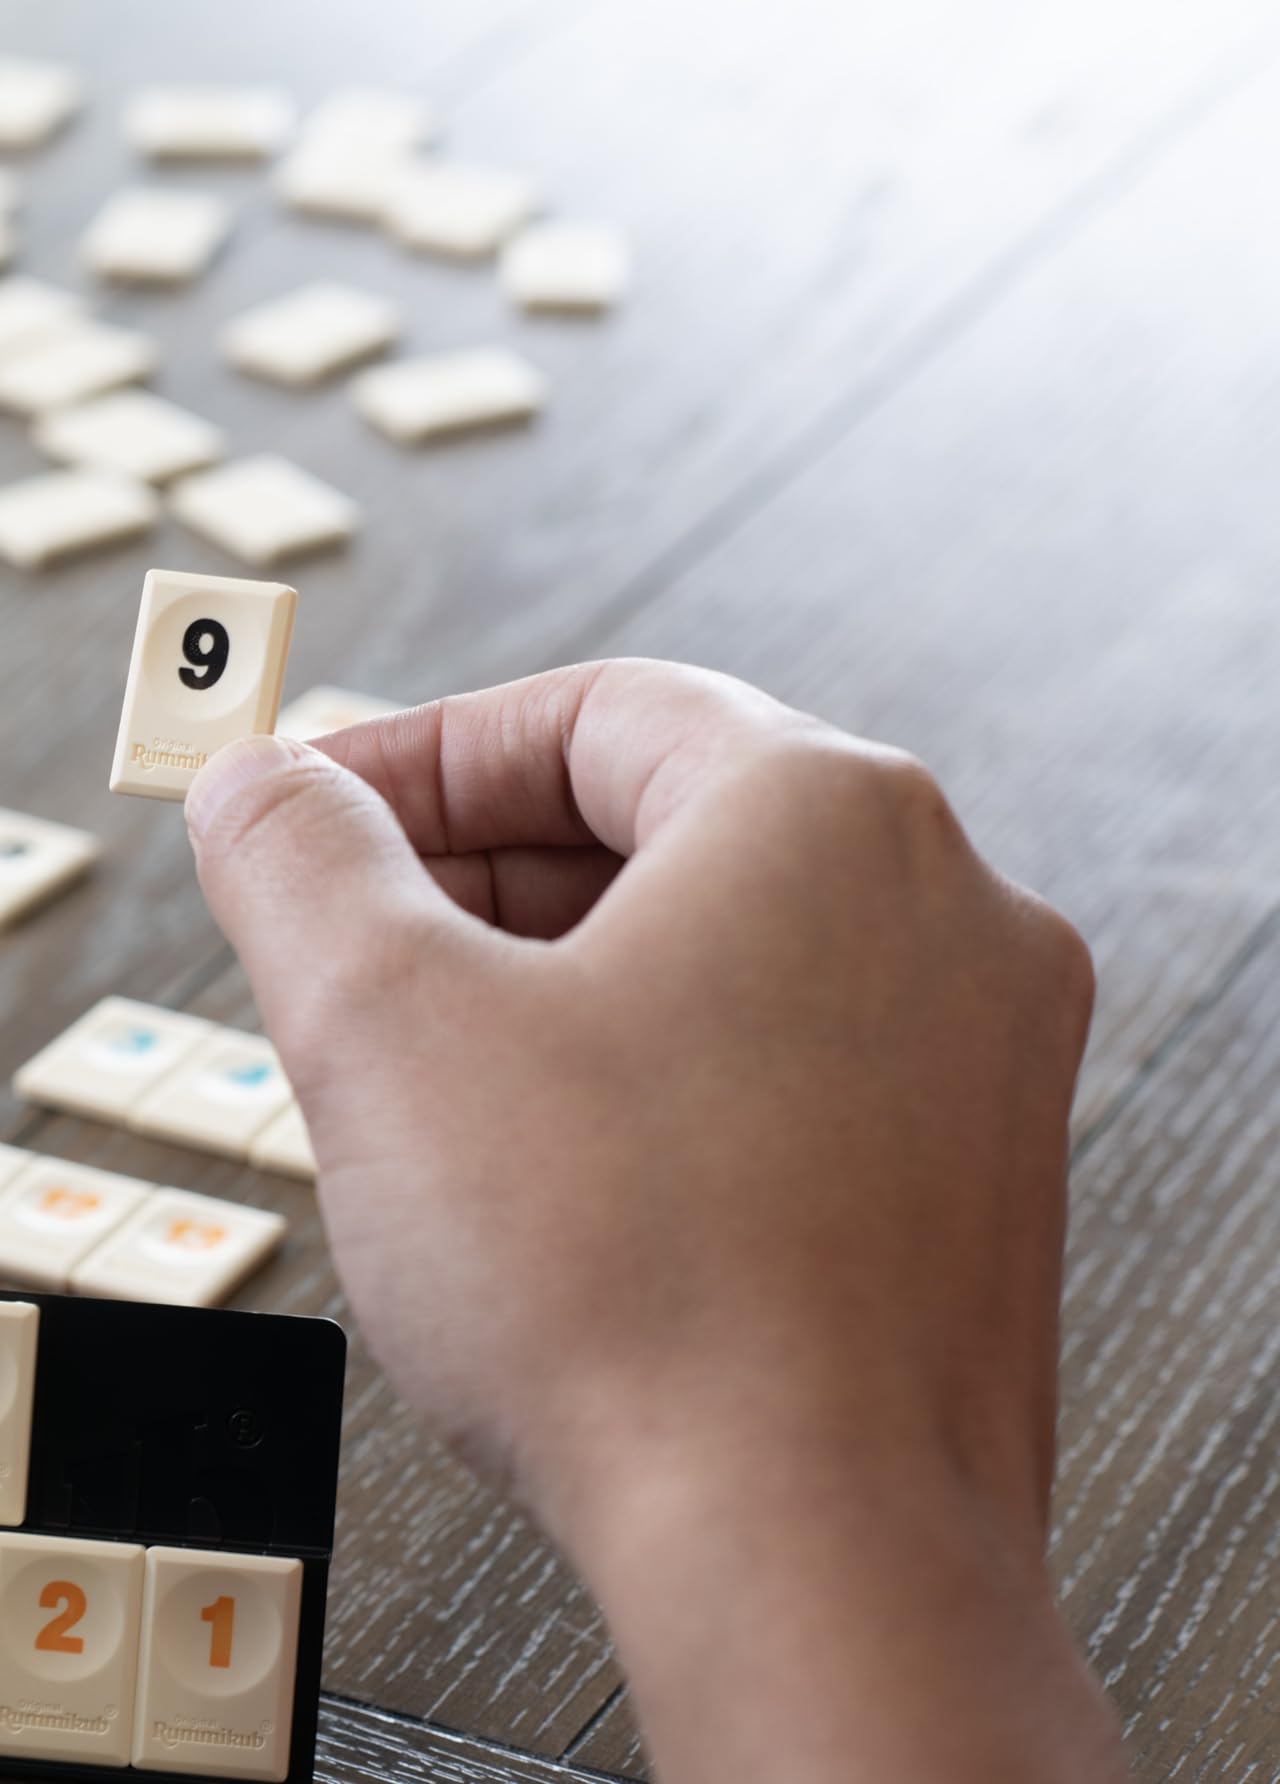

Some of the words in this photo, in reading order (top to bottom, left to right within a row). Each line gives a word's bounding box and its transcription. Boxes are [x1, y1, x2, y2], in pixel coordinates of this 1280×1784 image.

[178, 618, 230, 691] 9
[34, 1580, 87, 1654] 2
[200, 1595, 235, 1669] 1
